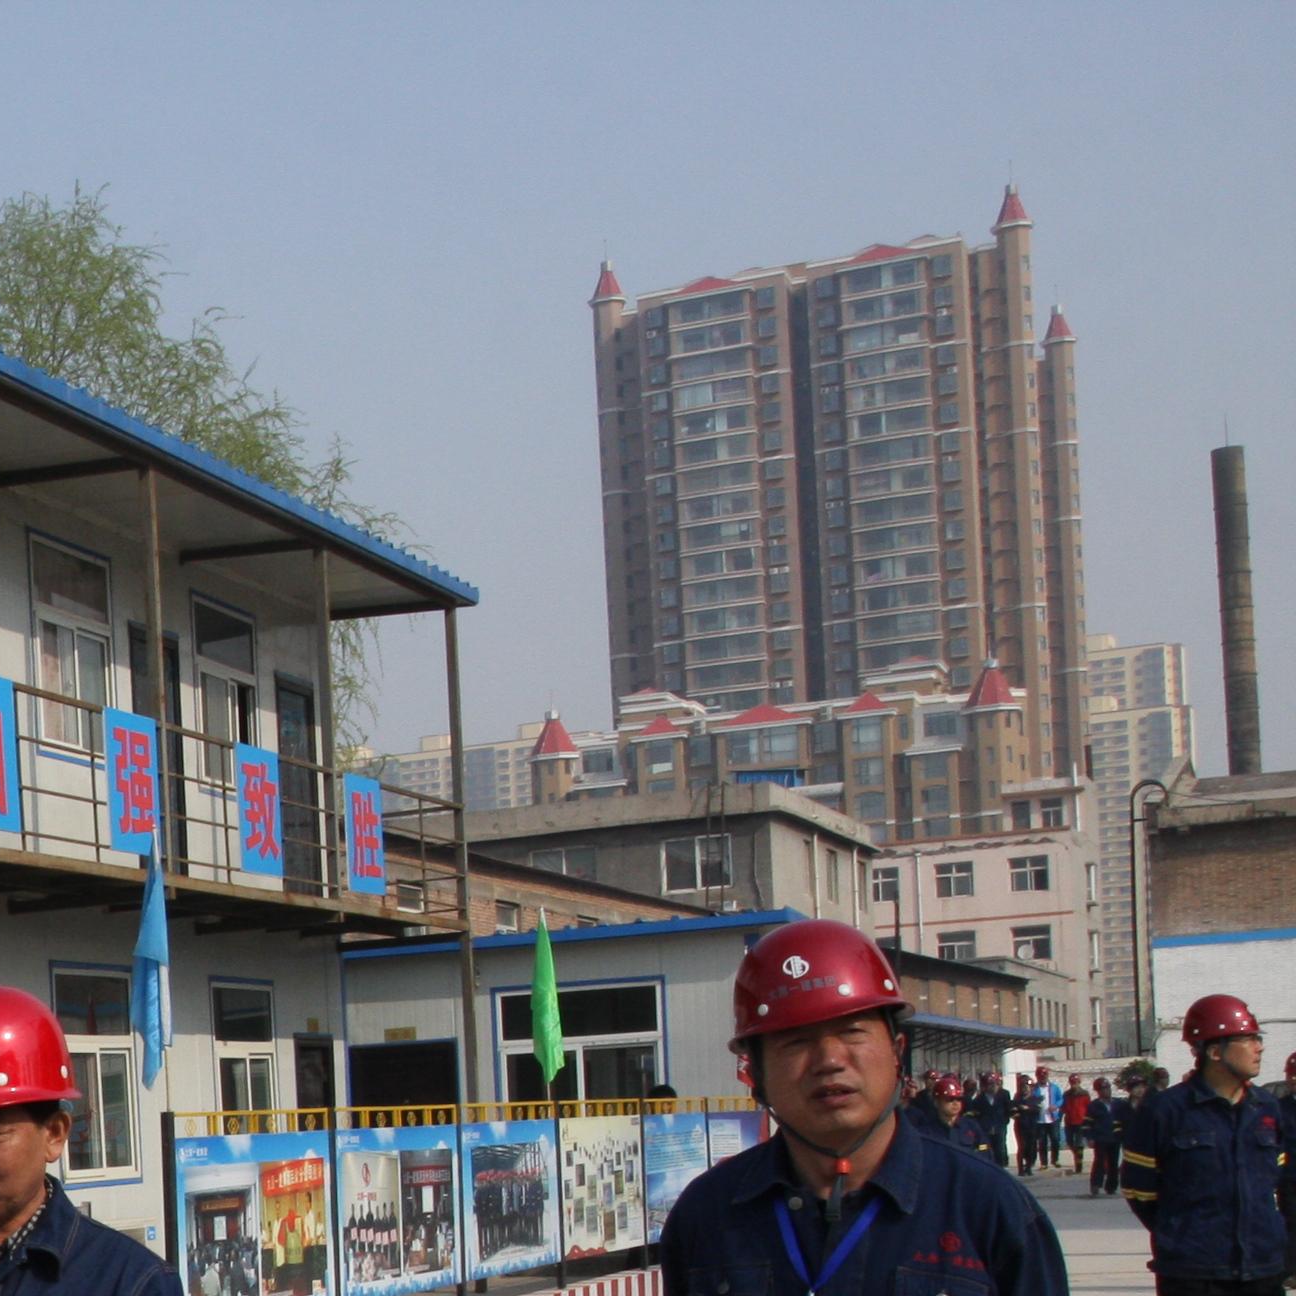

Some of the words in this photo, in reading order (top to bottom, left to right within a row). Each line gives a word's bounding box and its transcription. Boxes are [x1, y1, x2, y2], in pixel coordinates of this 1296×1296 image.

[113, 725, 156, 834] 强
[240, 761, 280, 861] 致
[350, 791, 383, 879] 胜
